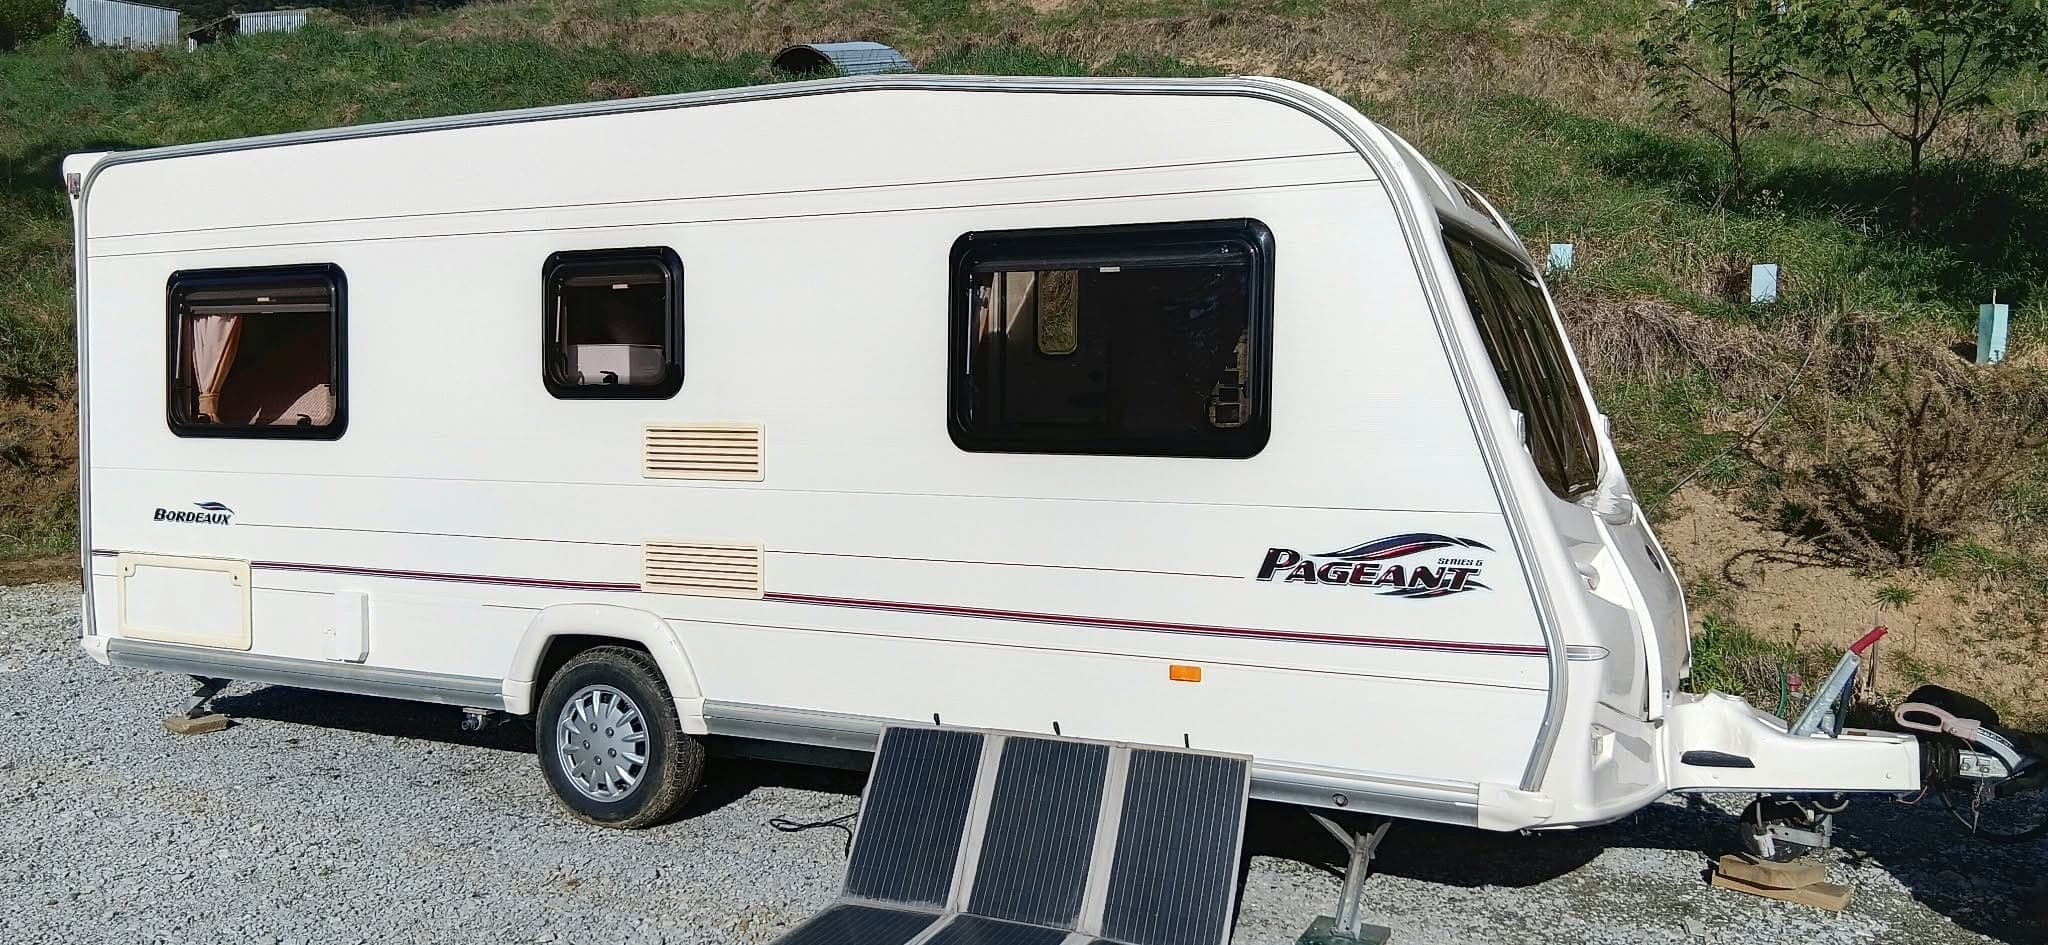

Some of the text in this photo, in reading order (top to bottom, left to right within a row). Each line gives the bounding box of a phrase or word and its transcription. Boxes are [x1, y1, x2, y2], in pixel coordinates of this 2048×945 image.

[153, 508, 231, 525] BORDEAUX
[1256, 547, 1480, 591] PAGEANT
[1437, 557, 1474, 566] SERIES
